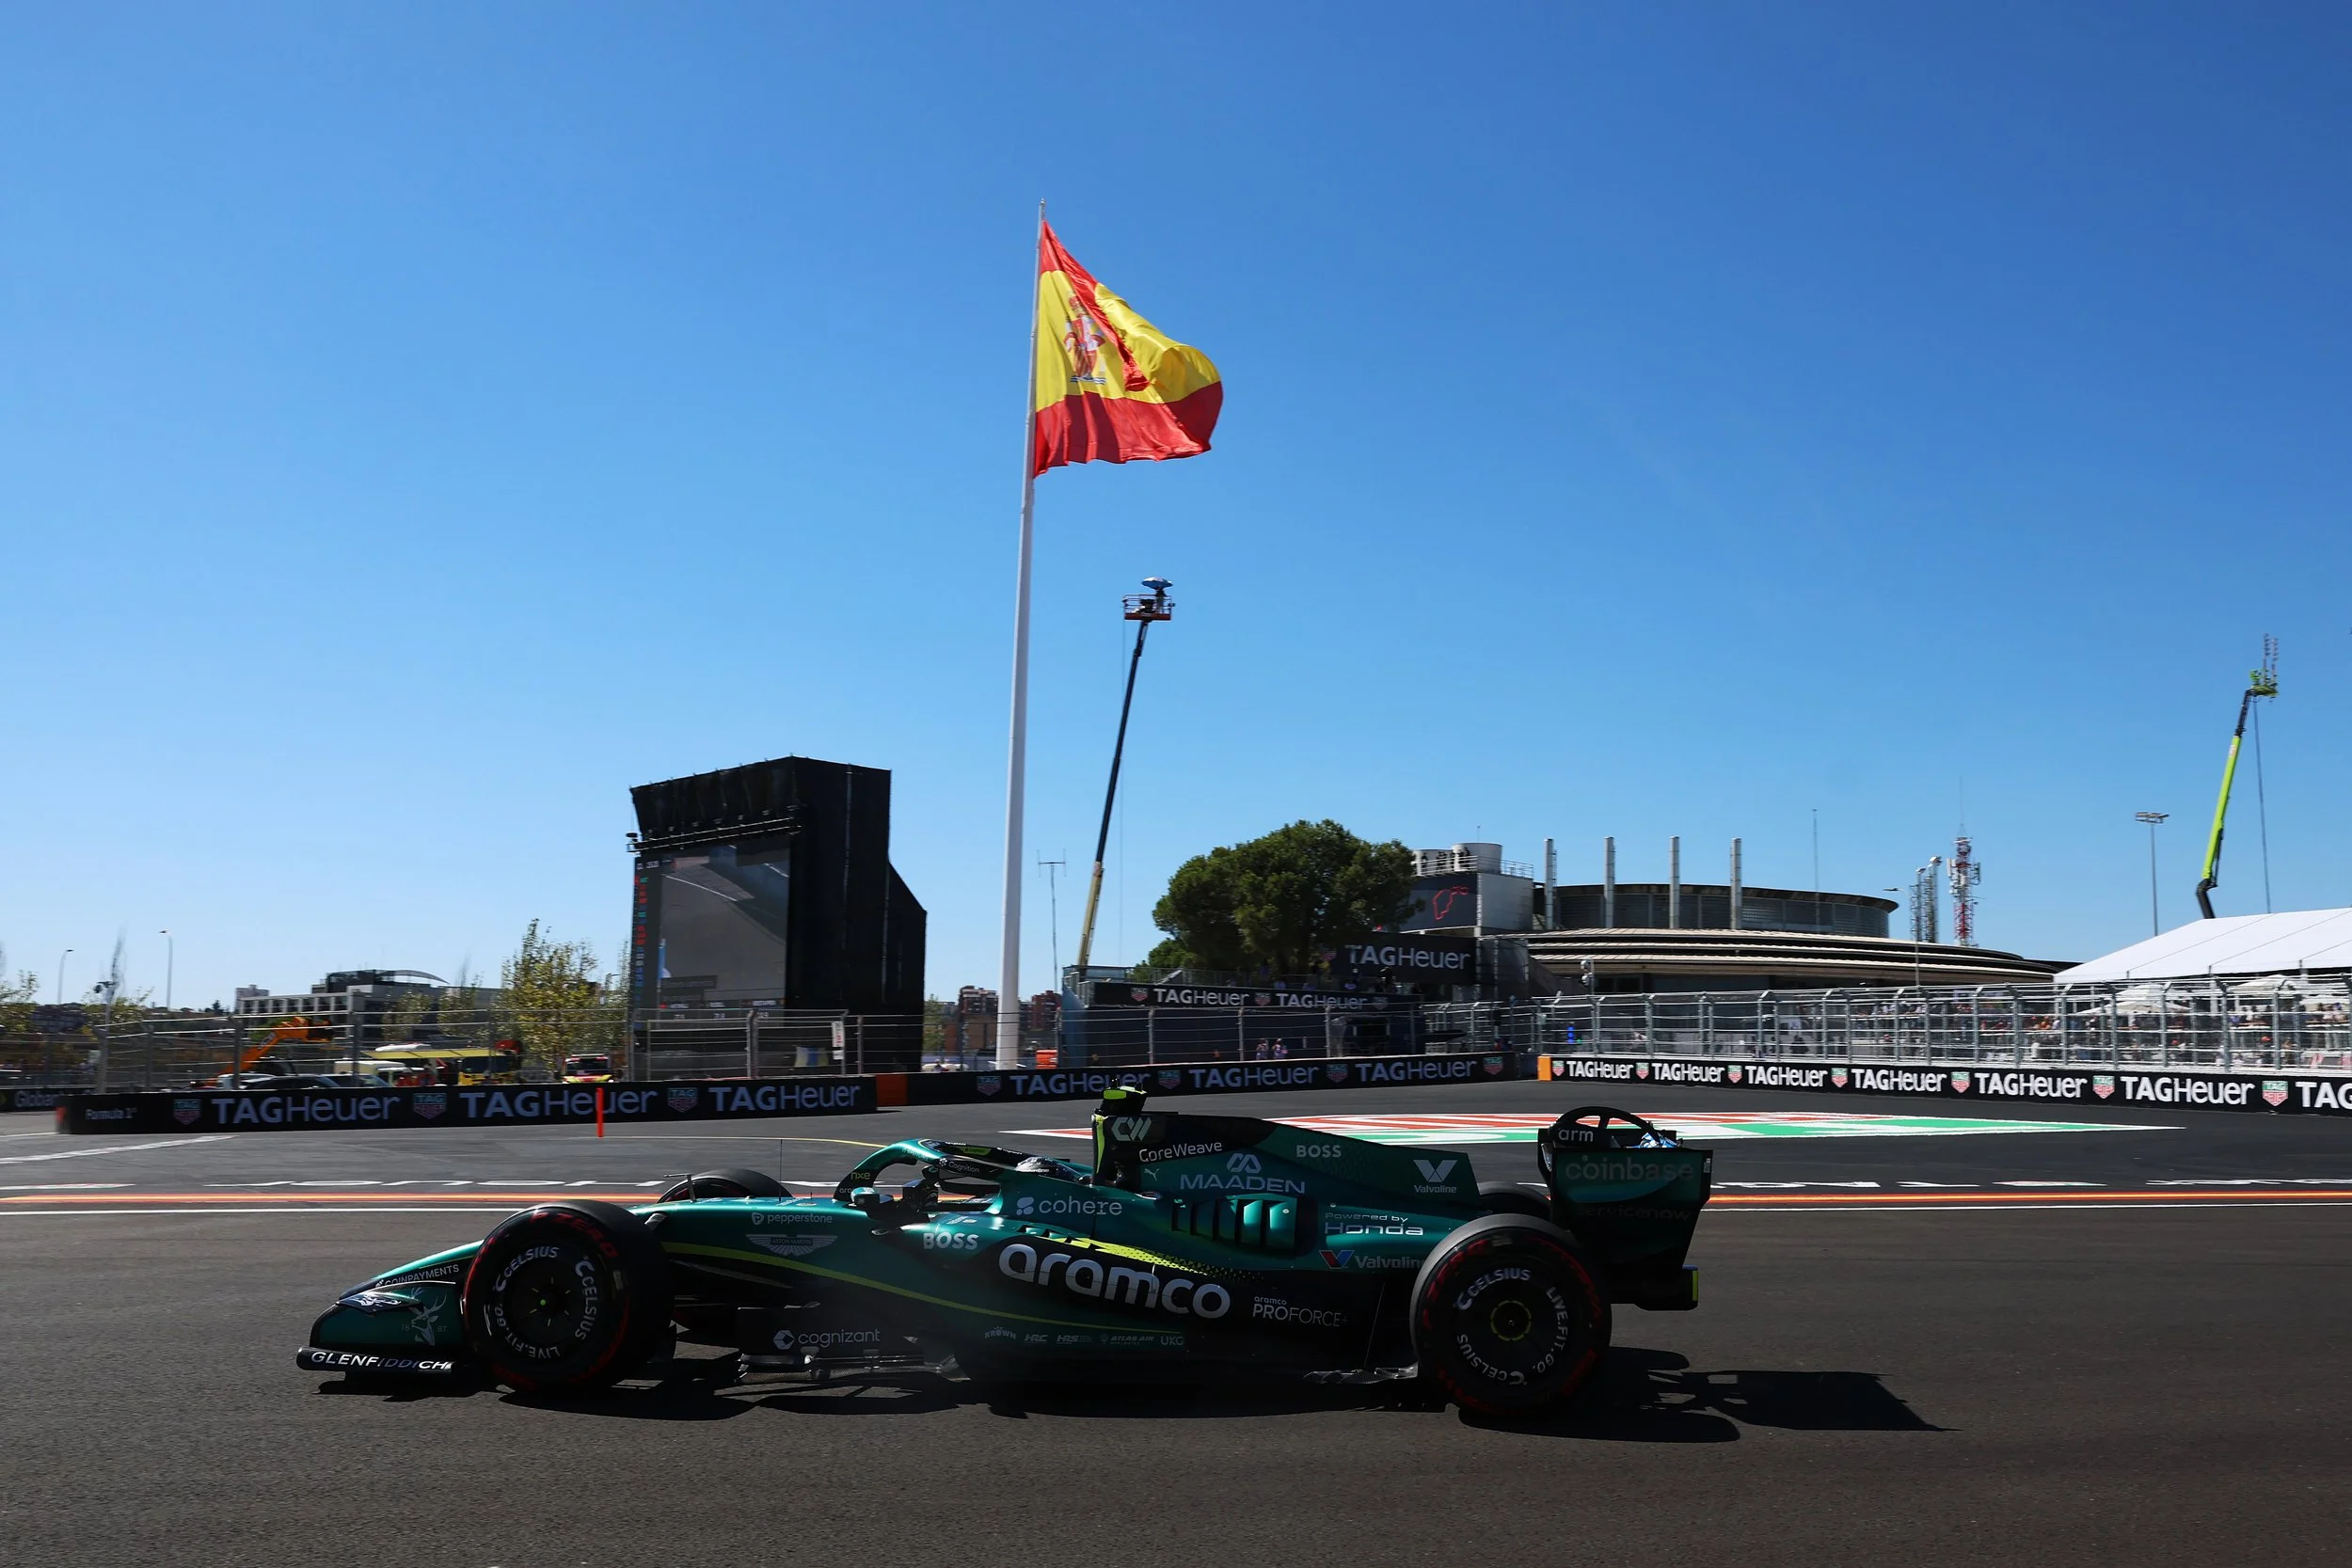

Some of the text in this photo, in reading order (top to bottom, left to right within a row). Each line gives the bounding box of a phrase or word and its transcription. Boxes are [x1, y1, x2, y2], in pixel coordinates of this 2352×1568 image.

[1558, 1128, 1594, 1143] arm
[1138, 1141, 1223, 1163] CoreWeave
[1295, 1144, 1342, 1159] BOSS
[1565, 1155, 1694, 1181] coinbase
[1180, 1174, 1306, 1194] MAADEN
[1414, 1184, 1457, 1194] Valvoline
[1039, 1196, 1122, 1216] cohere
[768, 1212, 833, 1225] pepperstone
[1325, 1212, 1388, 1221] Powered
[1325, 1222, 1423, 1236] Honda
[923, 1231, 978, 1250] BOSS
[999, 1243, 1231, 1319] aramco
[1253, 1295, 1288, 1306] aramco
[798, 1328, 881, 1347] cognizant
[310, 1351, 449, 1370] GLENFIDDICH
